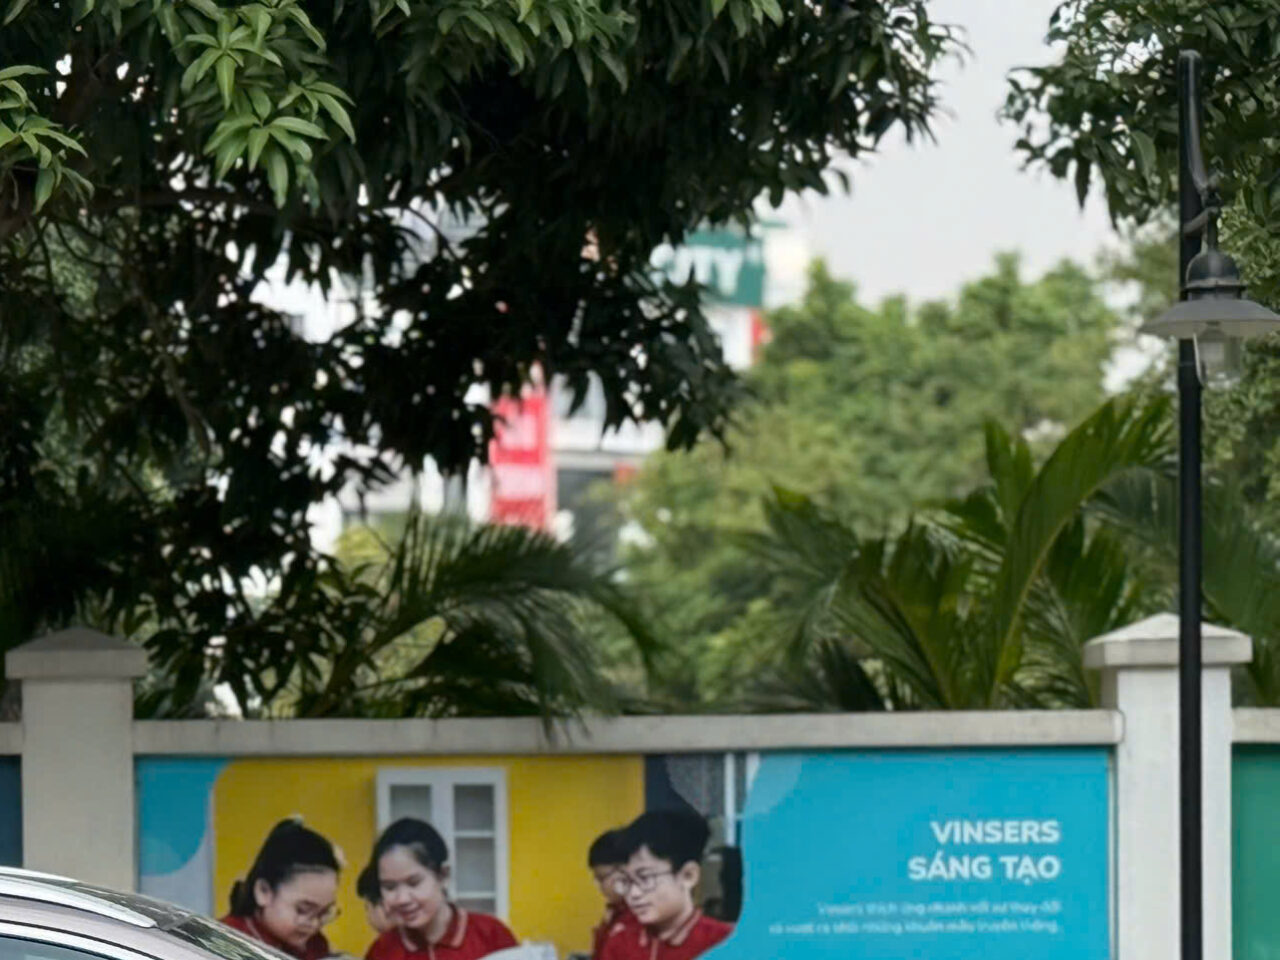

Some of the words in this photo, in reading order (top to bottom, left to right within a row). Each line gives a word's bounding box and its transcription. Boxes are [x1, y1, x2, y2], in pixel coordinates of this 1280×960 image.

[929, 819, 1062, 845] VINSERS
[907, 850, 993, 881] SÁNG
[998, 854, 1062, 886] TẠO
